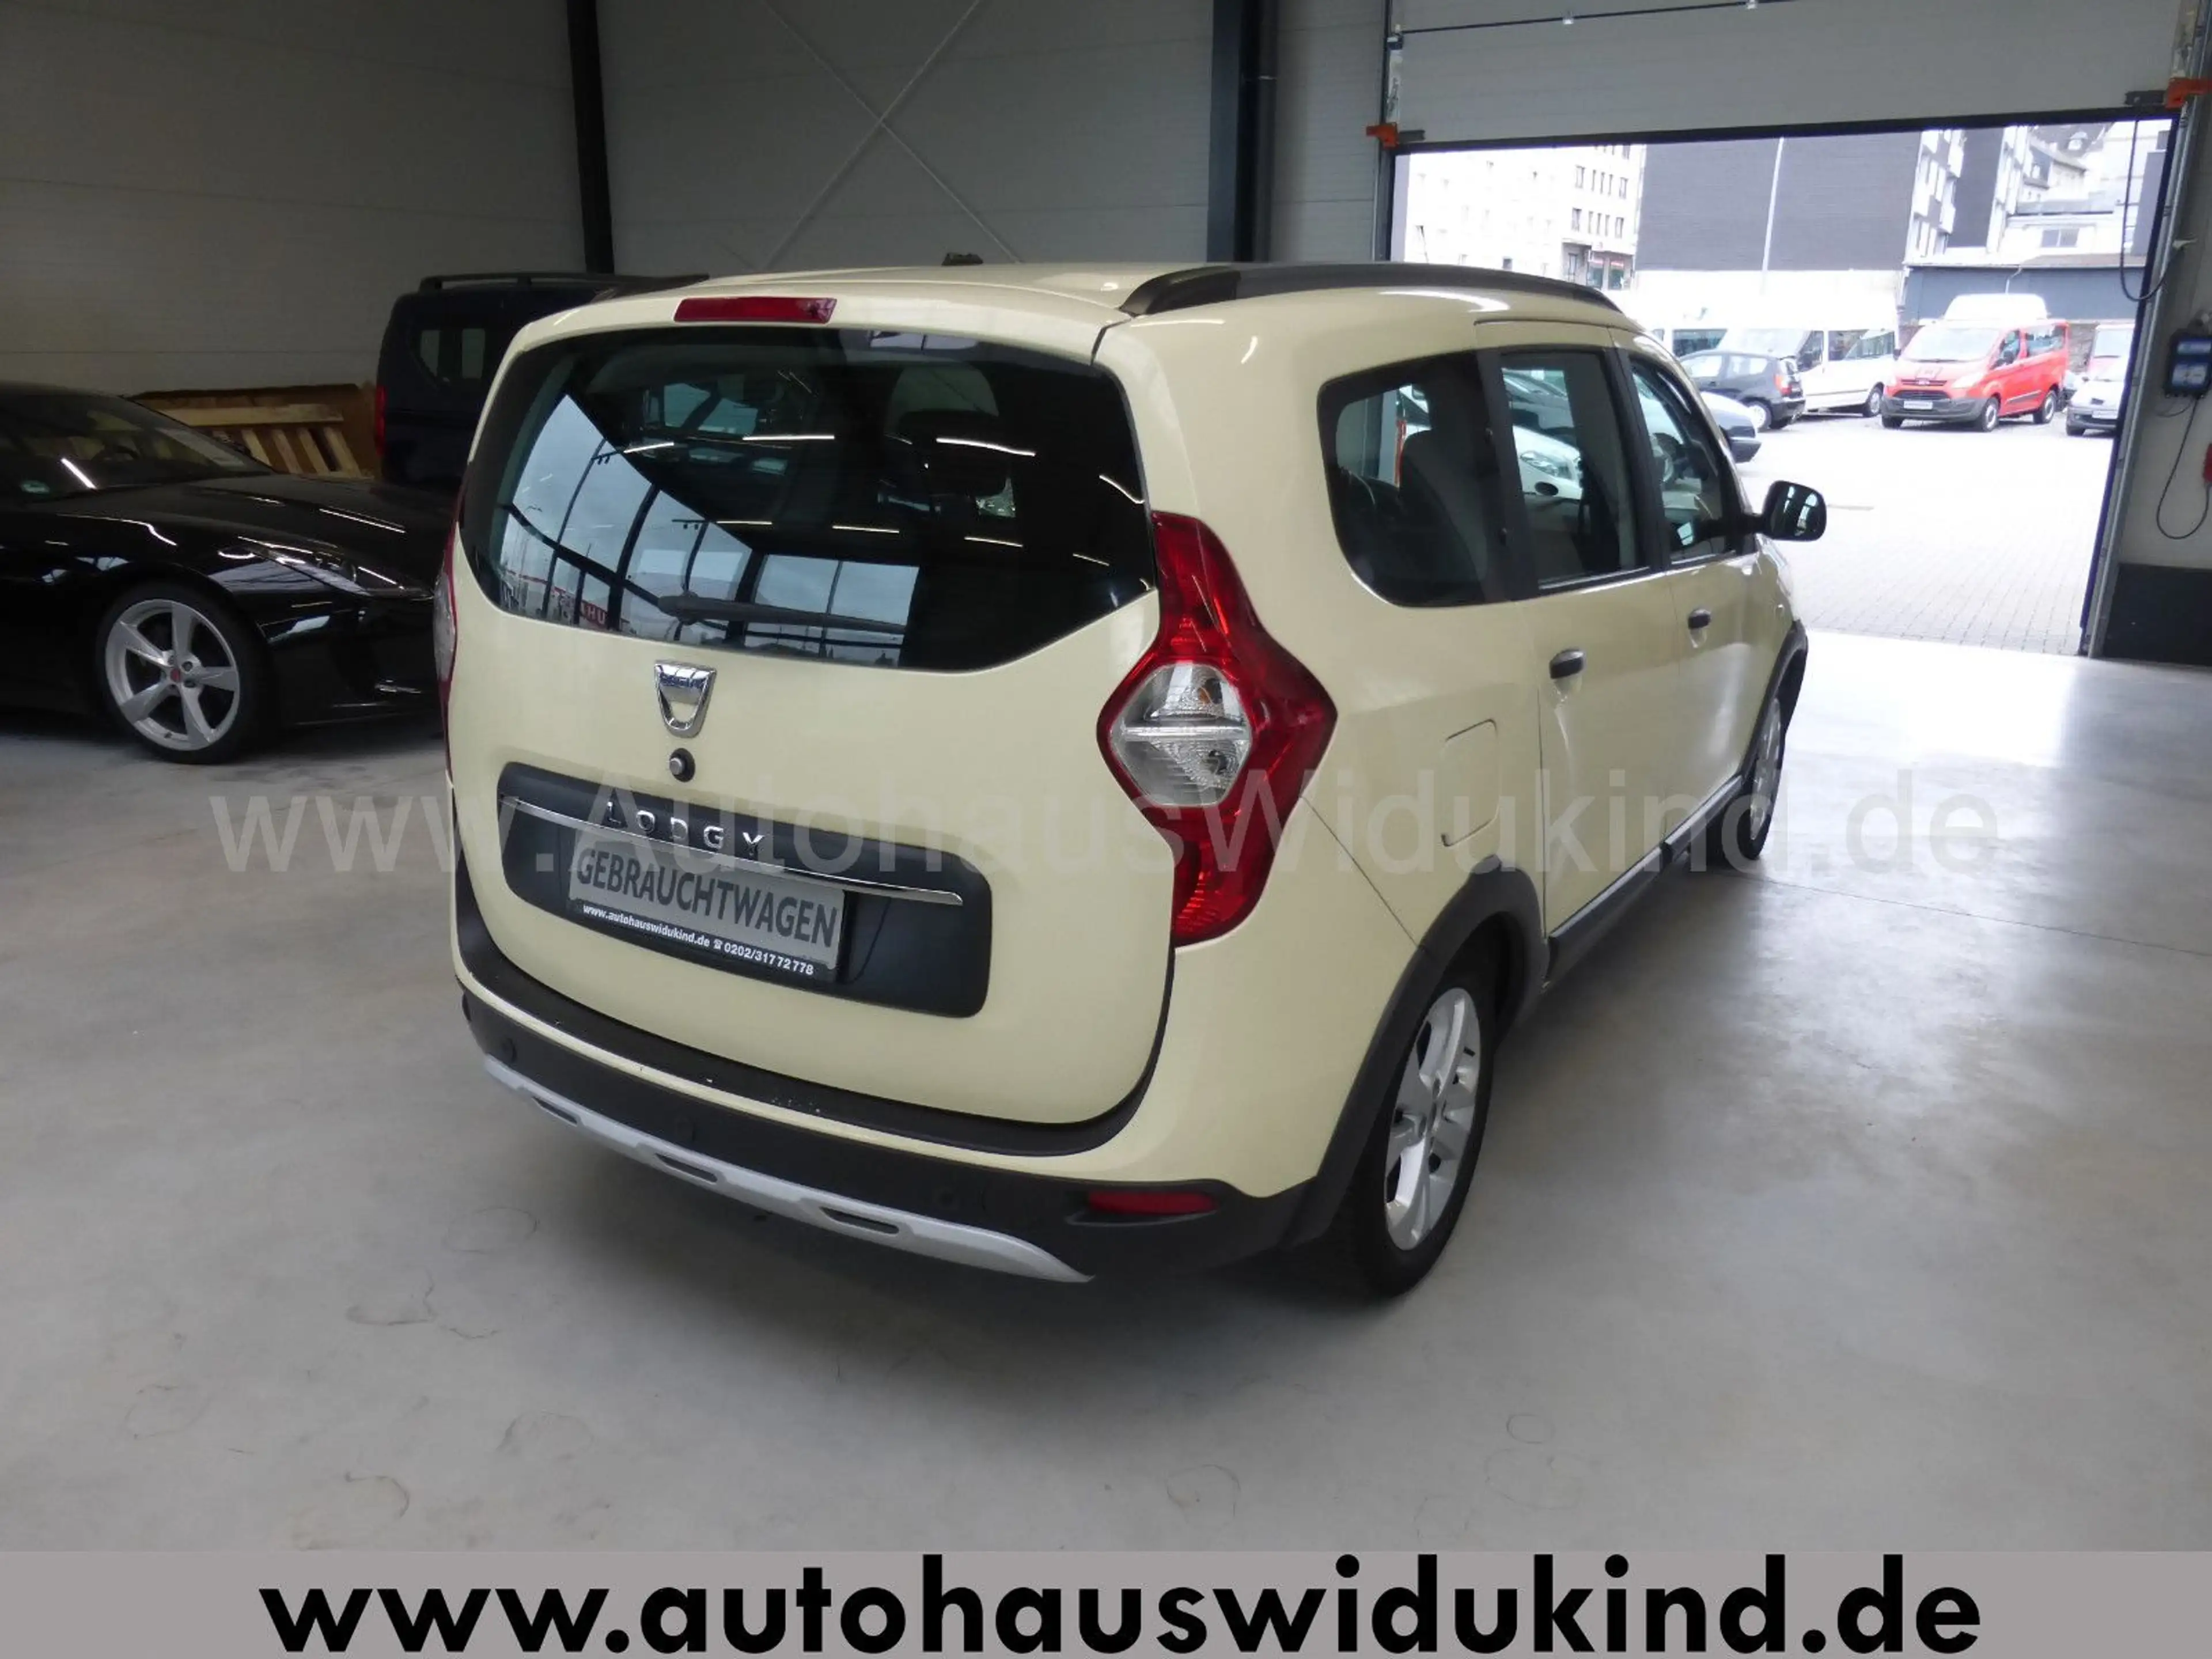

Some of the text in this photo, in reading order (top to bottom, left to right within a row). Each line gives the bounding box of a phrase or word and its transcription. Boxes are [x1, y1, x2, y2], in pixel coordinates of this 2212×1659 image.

[606, 801, 765, 857] LODGY
[577, 847, 837, 948] GEBRAUCHTWAGEN
[583, 904, 710, 948] www.autohauswidukind.de
